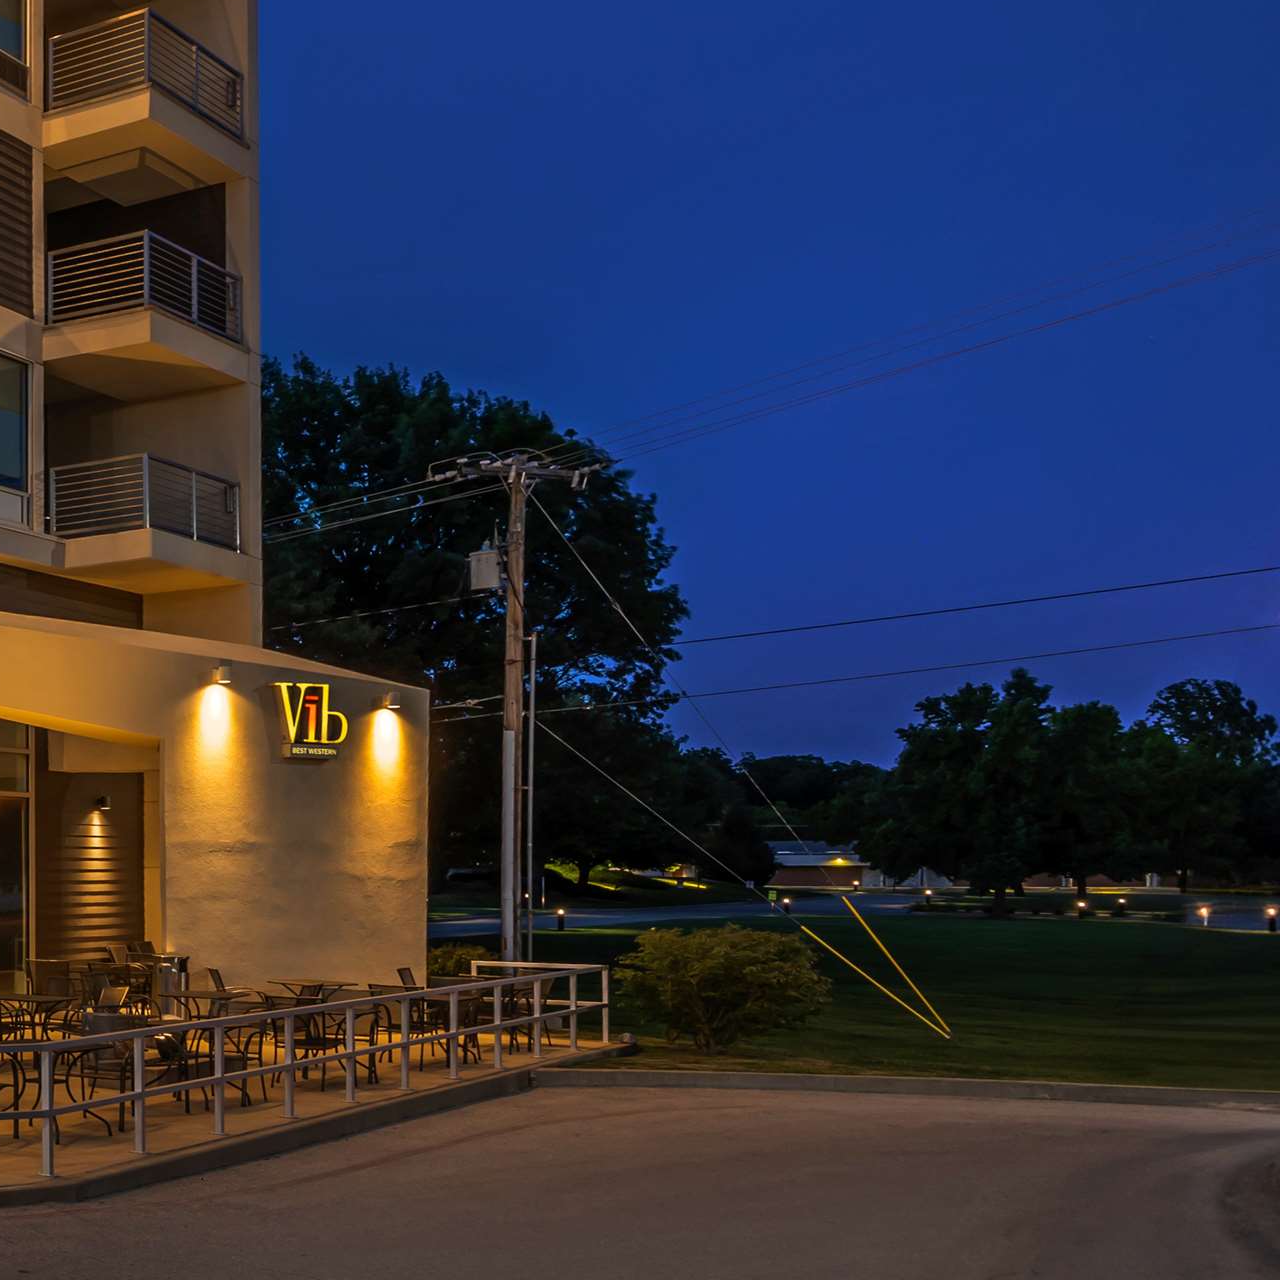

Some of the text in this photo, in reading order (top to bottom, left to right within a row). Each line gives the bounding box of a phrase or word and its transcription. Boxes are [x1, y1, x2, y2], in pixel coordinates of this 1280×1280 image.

[273, 682, 349, 744] Vib
[292, 747, 337, 756] BEST WESTERN
